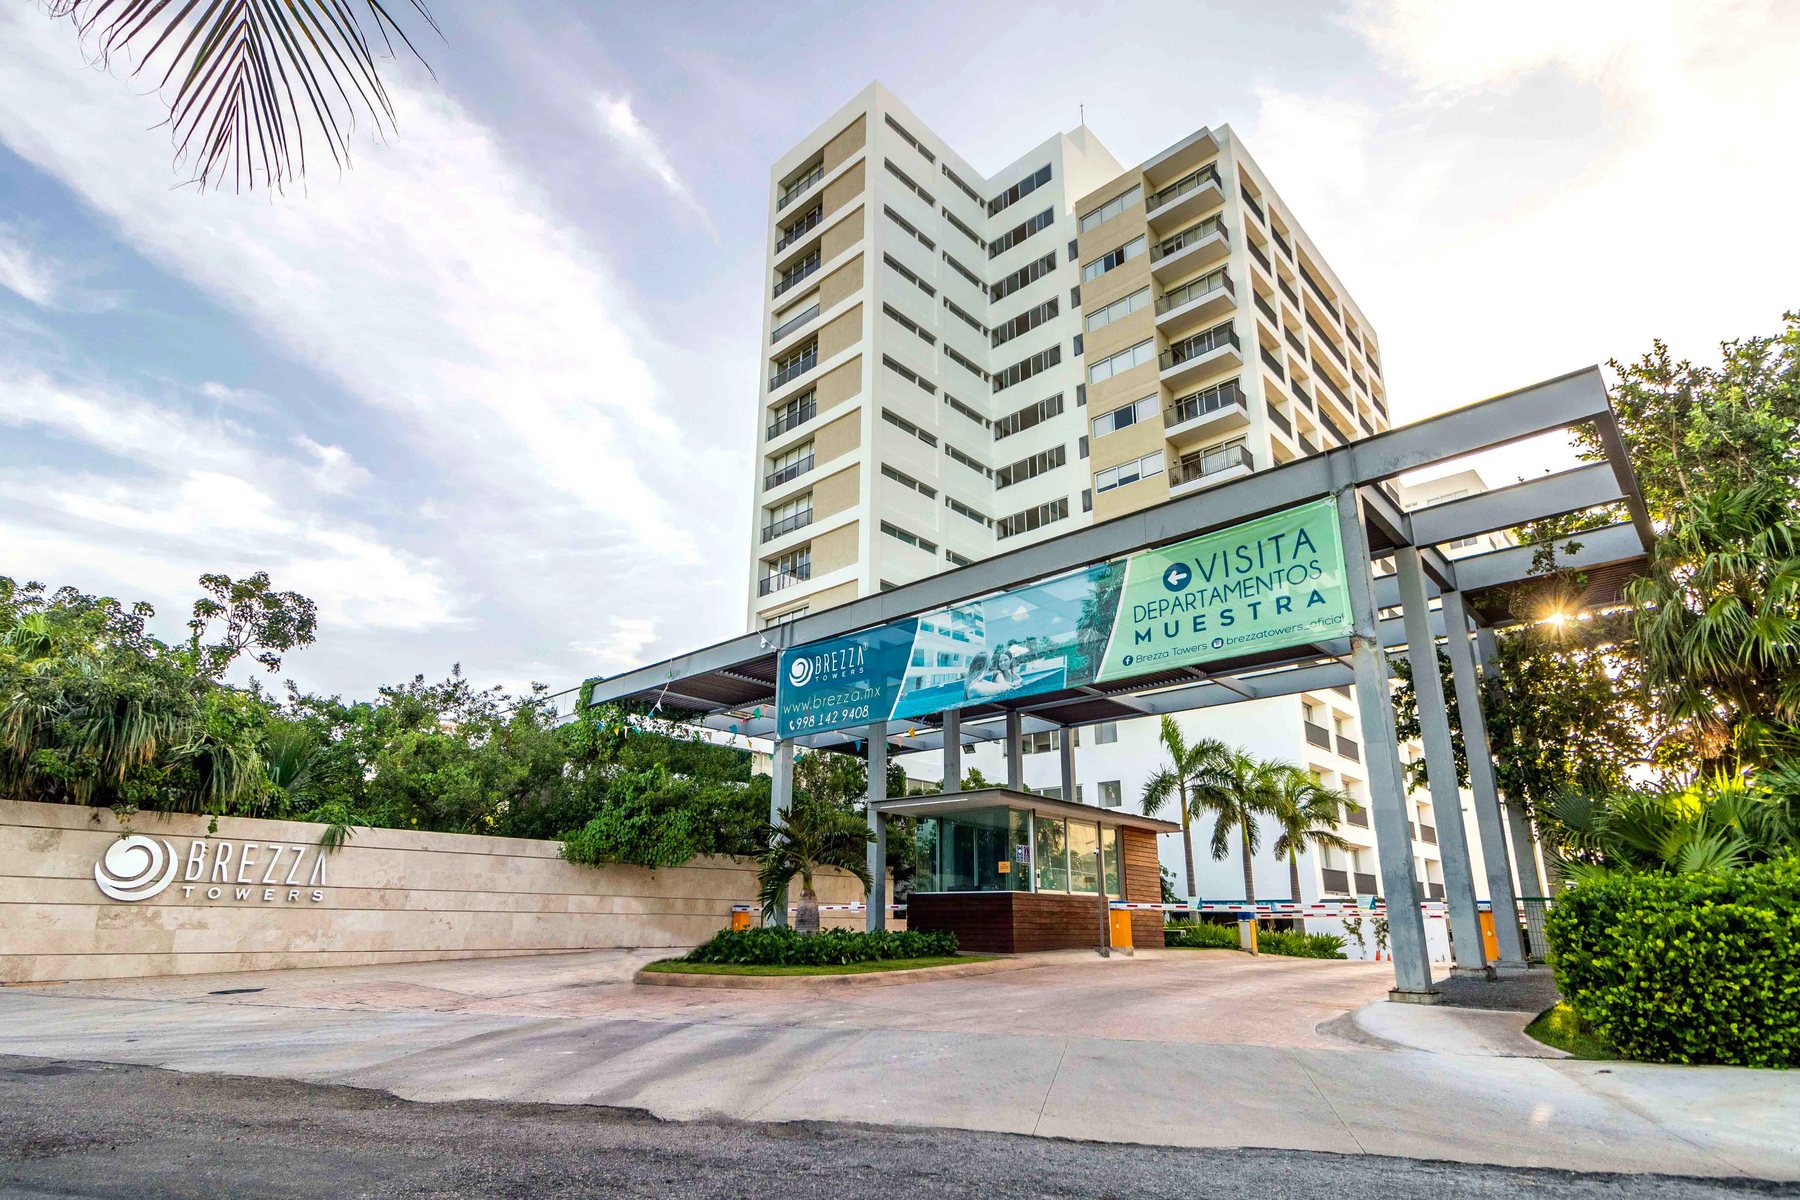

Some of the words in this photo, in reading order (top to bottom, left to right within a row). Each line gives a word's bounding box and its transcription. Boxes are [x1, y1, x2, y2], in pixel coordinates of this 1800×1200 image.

[1195, 527, 1317, 583] VISITA
[1133, 559, 1322, 623] DEPARTAMENTOS
[1134, 588, 1326, 645] MUESTRA
[1226, 613, 1345, 645] brezzatowers_oficial
[815, 645, 864, 675] BREZZA
[1135, 650, 1169, 664] Brezza
[1171, 642, 1208, 656] Towers
[815, 667, 864, 682] TOWERS
[783, 687, 880, 714] www.brezza.mx
[796, 715, 815, 730] 998
[818, 710, 838, 726] 142
[842, 705, 869, 721] 9408
[184, 840, 327, 886] BREZZA
[182, 885, 325, 902] TOWERS
